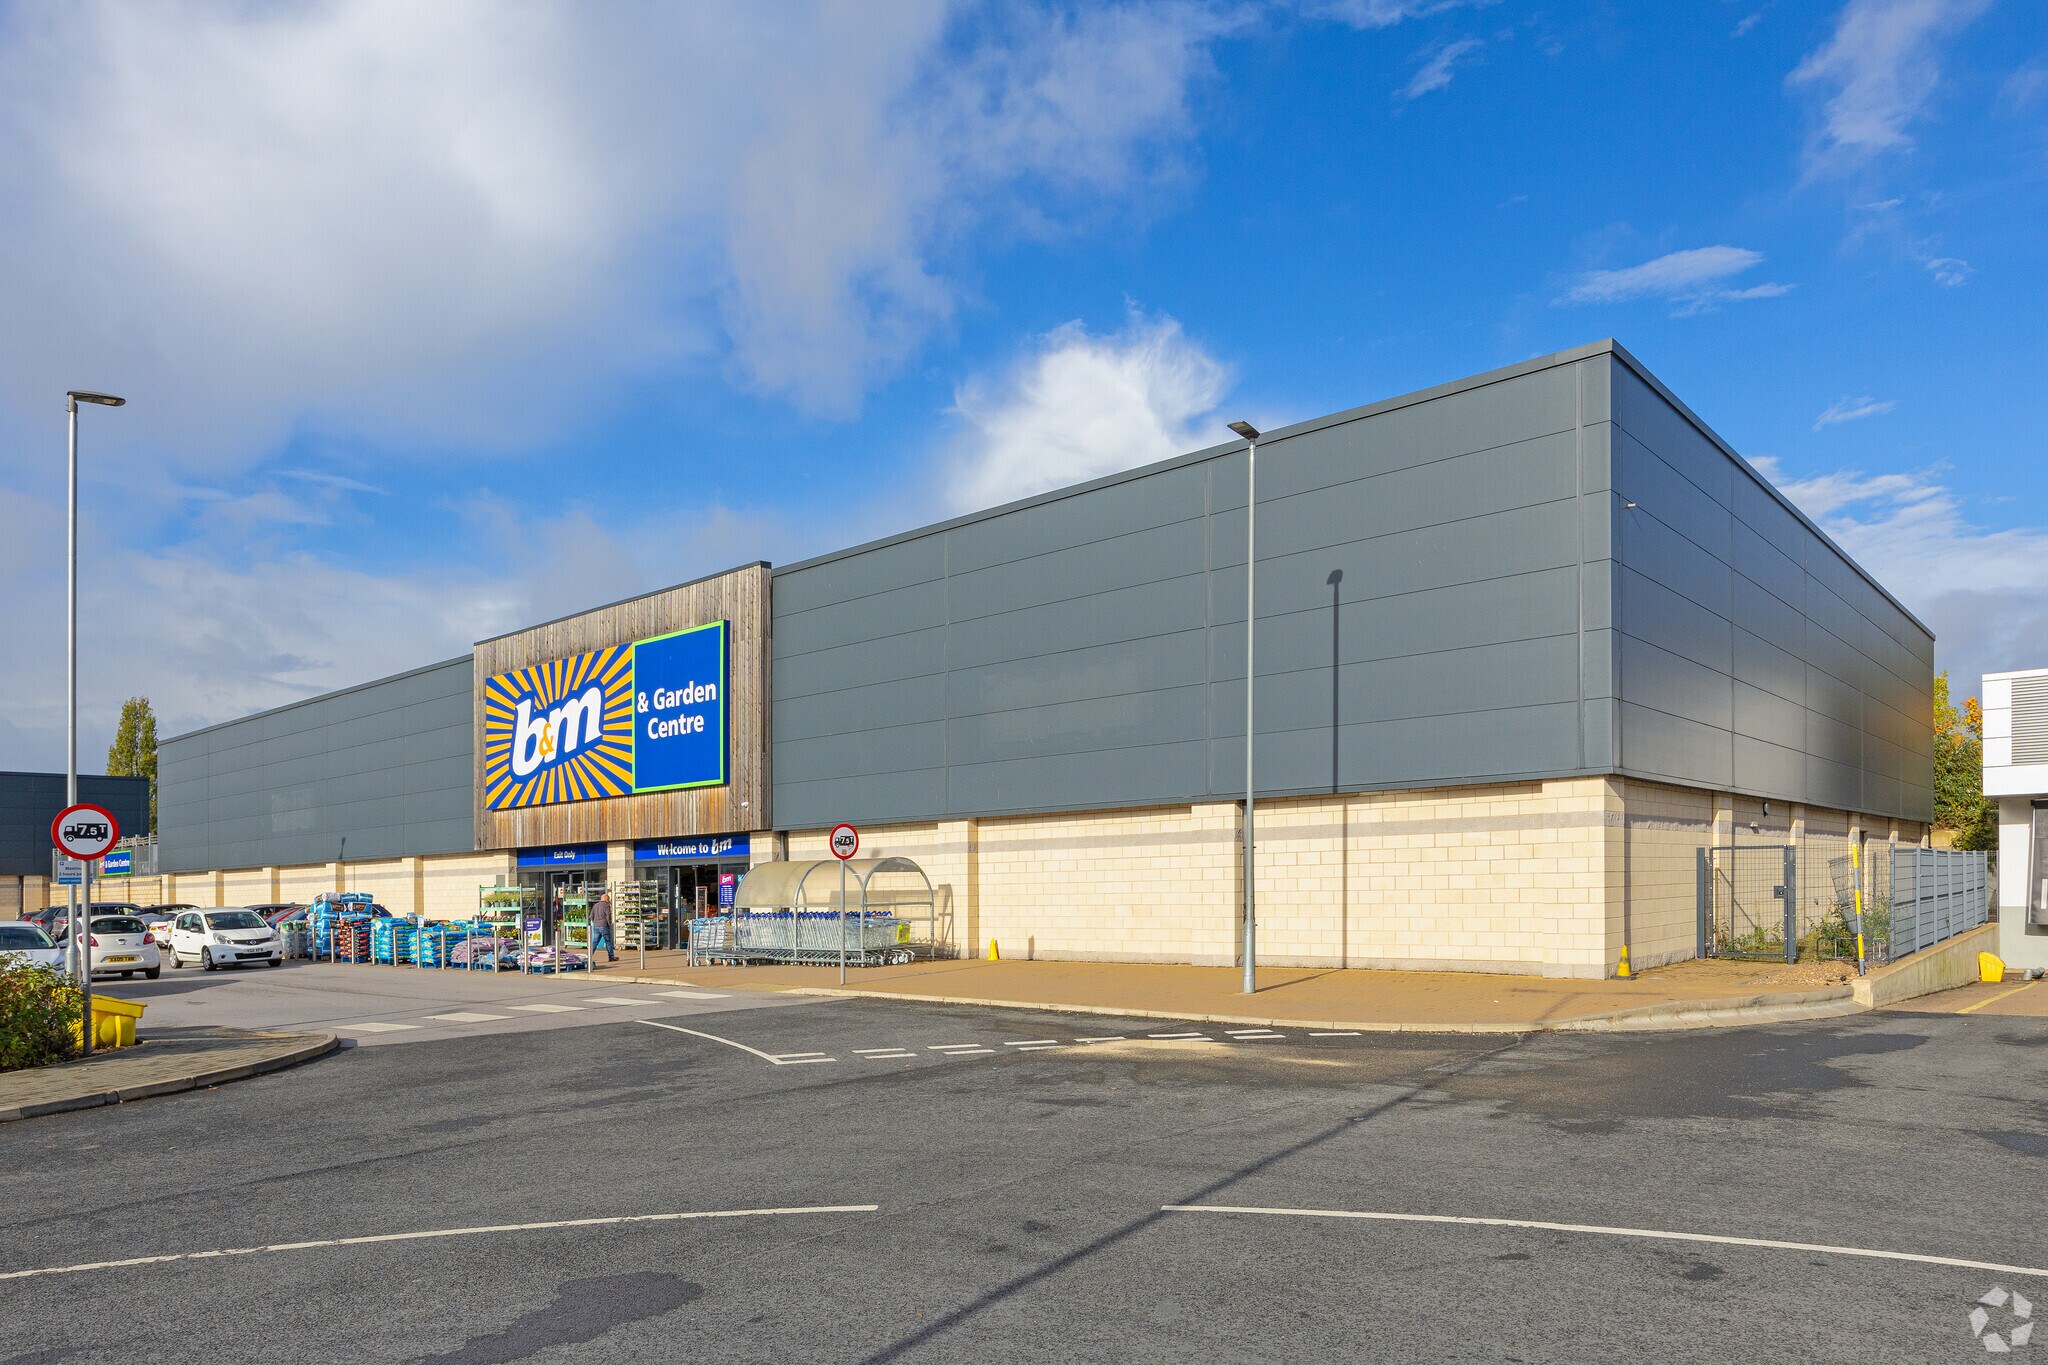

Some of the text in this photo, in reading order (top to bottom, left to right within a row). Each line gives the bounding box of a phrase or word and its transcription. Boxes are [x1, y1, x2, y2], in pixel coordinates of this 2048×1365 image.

[637, 681, 717, 713] & Garden
[647, 715, 705, 740] Centre
[554, 850, 576, 860] Exit Only
[657, 843, 697, 856] Welcome
[698, 842, 709, 854] to
